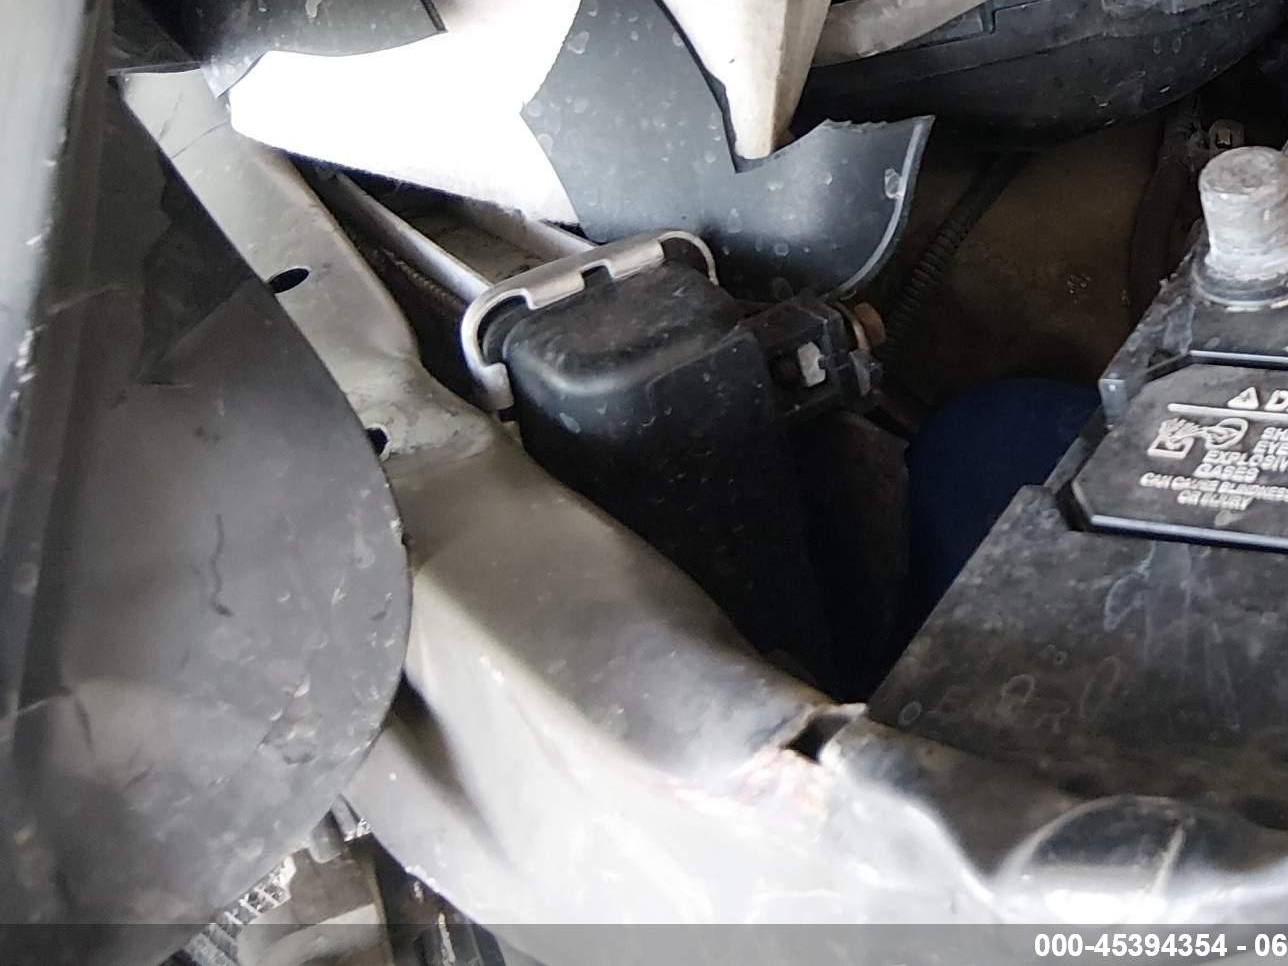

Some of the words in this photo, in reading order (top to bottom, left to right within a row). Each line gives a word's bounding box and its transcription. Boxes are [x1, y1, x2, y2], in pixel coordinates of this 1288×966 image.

[1140, 472, 1172, 489] CAN
[1192, 463, 1260, 483] GASES
[1177, 489, 1201, 505] OR
